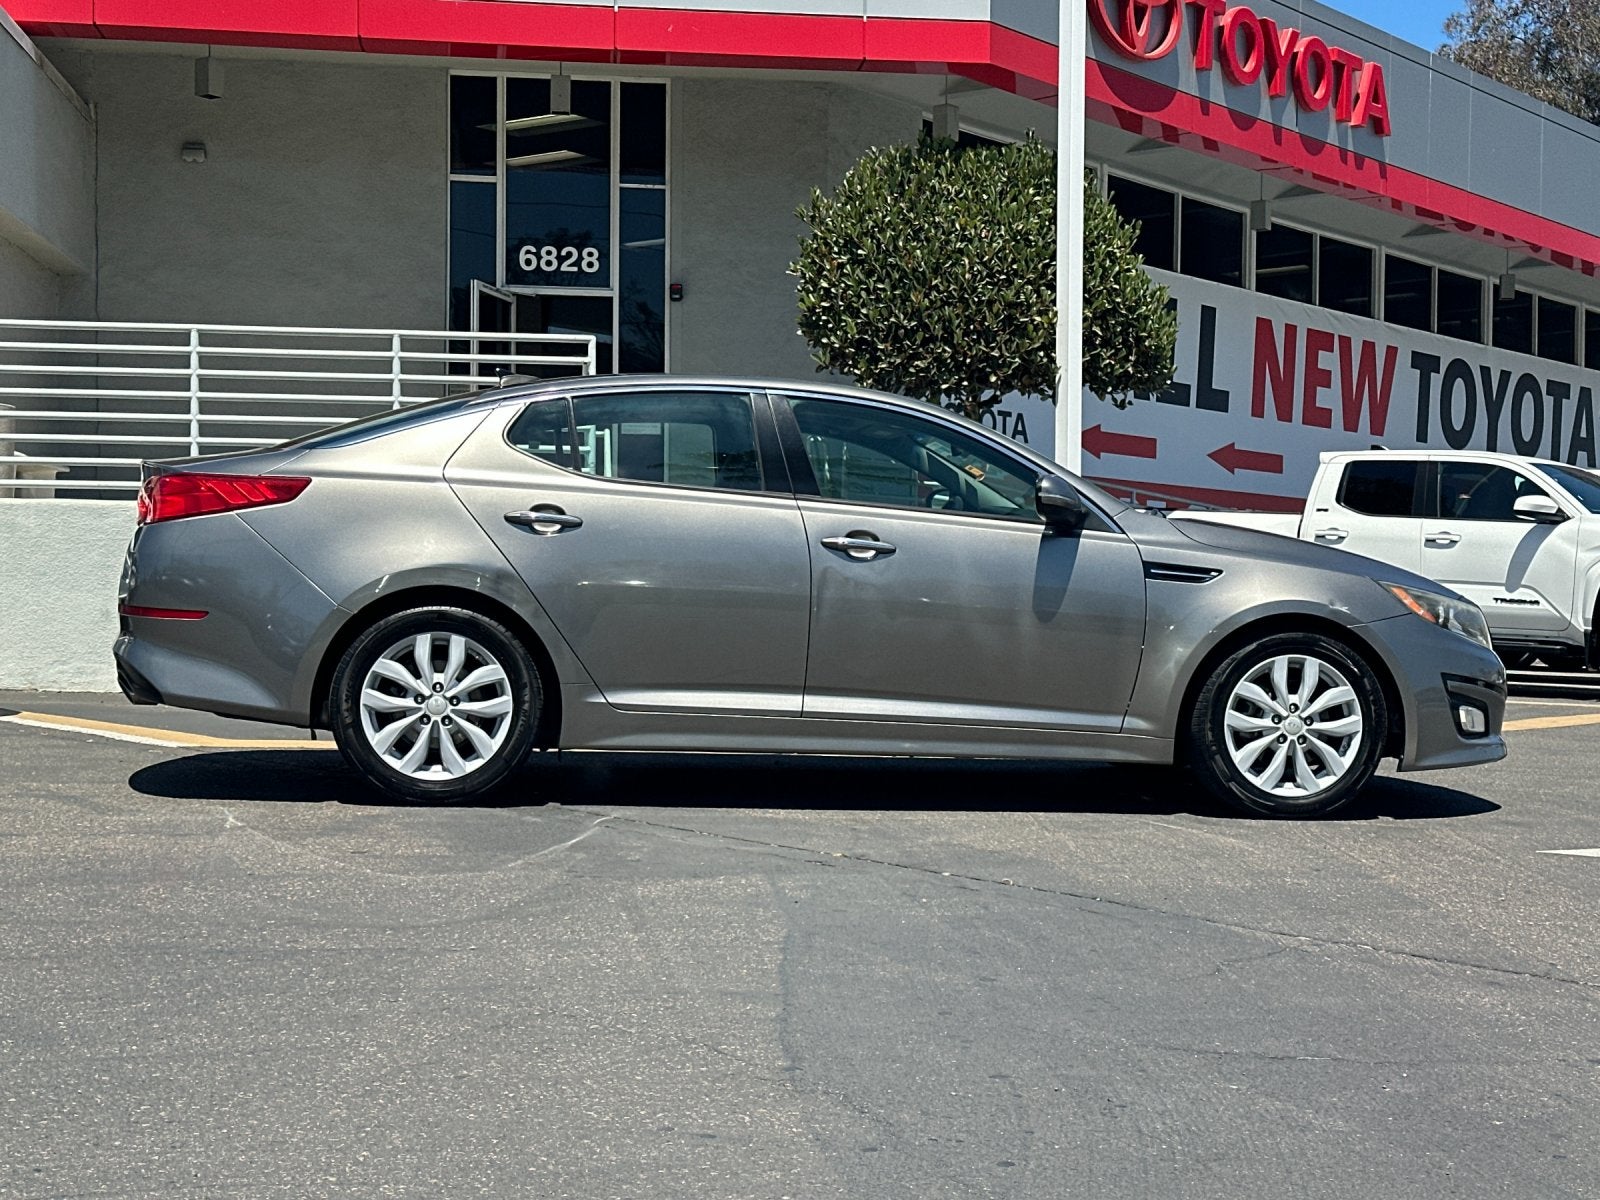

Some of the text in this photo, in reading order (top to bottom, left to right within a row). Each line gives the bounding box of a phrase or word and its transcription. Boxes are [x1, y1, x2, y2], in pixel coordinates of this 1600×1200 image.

[1184, 0, 1391, 137] TOYOTA
[519, 245, 599, 273] 6828
[1134, 298, 1597, 468] LL NEW TOYOTA
